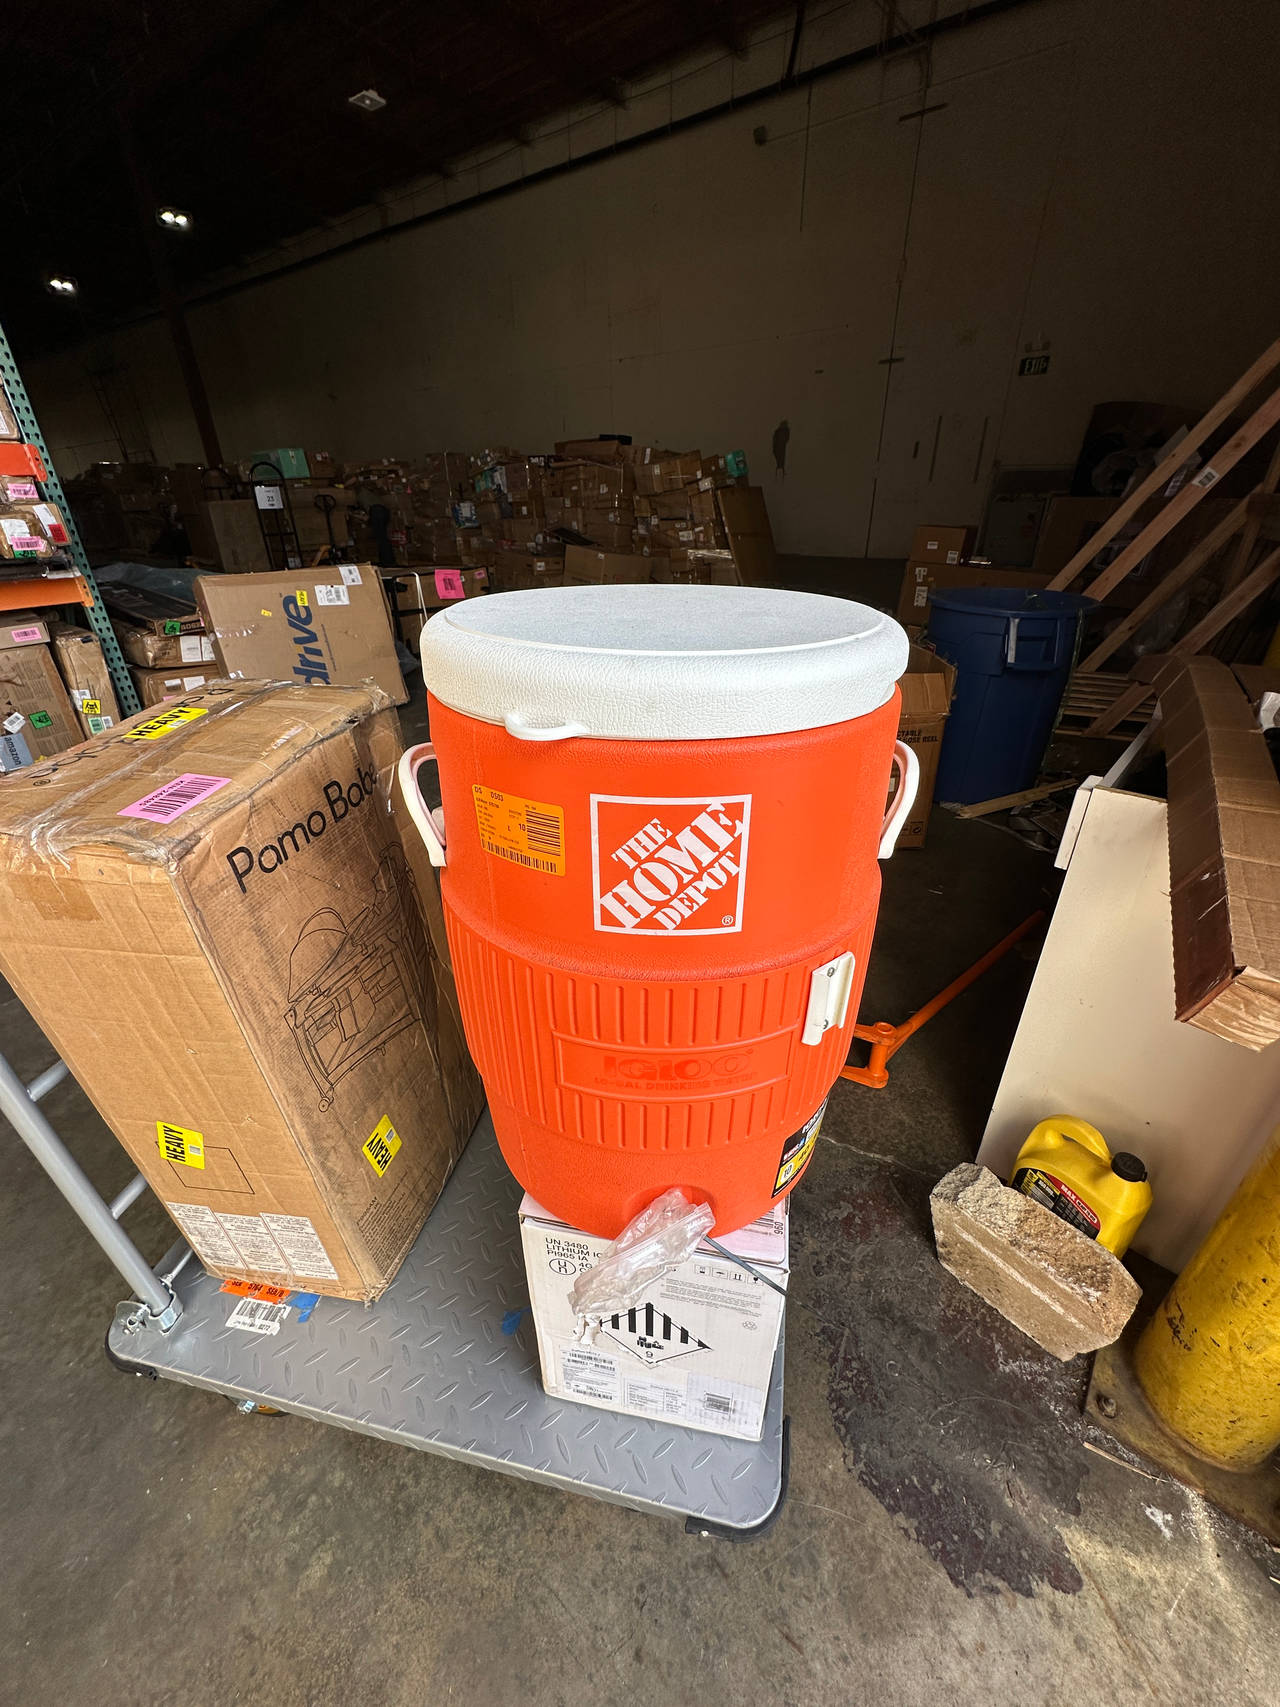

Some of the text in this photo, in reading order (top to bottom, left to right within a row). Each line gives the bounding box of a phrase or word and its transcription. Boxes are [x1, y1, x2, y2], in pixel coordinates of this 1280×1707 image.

[132, 707, 192, 737] HEAVY
[4, 736, 22, 766] amazon
[226, 762, 378, 895] Pamo Babe
[610, 817, 674, 870] THE
[600, 801, 745, 929] HOME
[652, 850, 741, 930] DEPOT
[603, 1053, 751, 1081] IGLOO
[163, 1125, 187, 1163] HEAVY
[366, 1132, 393, 1171] HEAVY
[773, 1221, 784, 1235] 960
[545, 1237, 589, 1250] UN 3480
[546, 1244, 590, 1256] LITHIUM
[547, 1250, 575, 1259] PI965
[645, 1350, 654, 1358] 9
